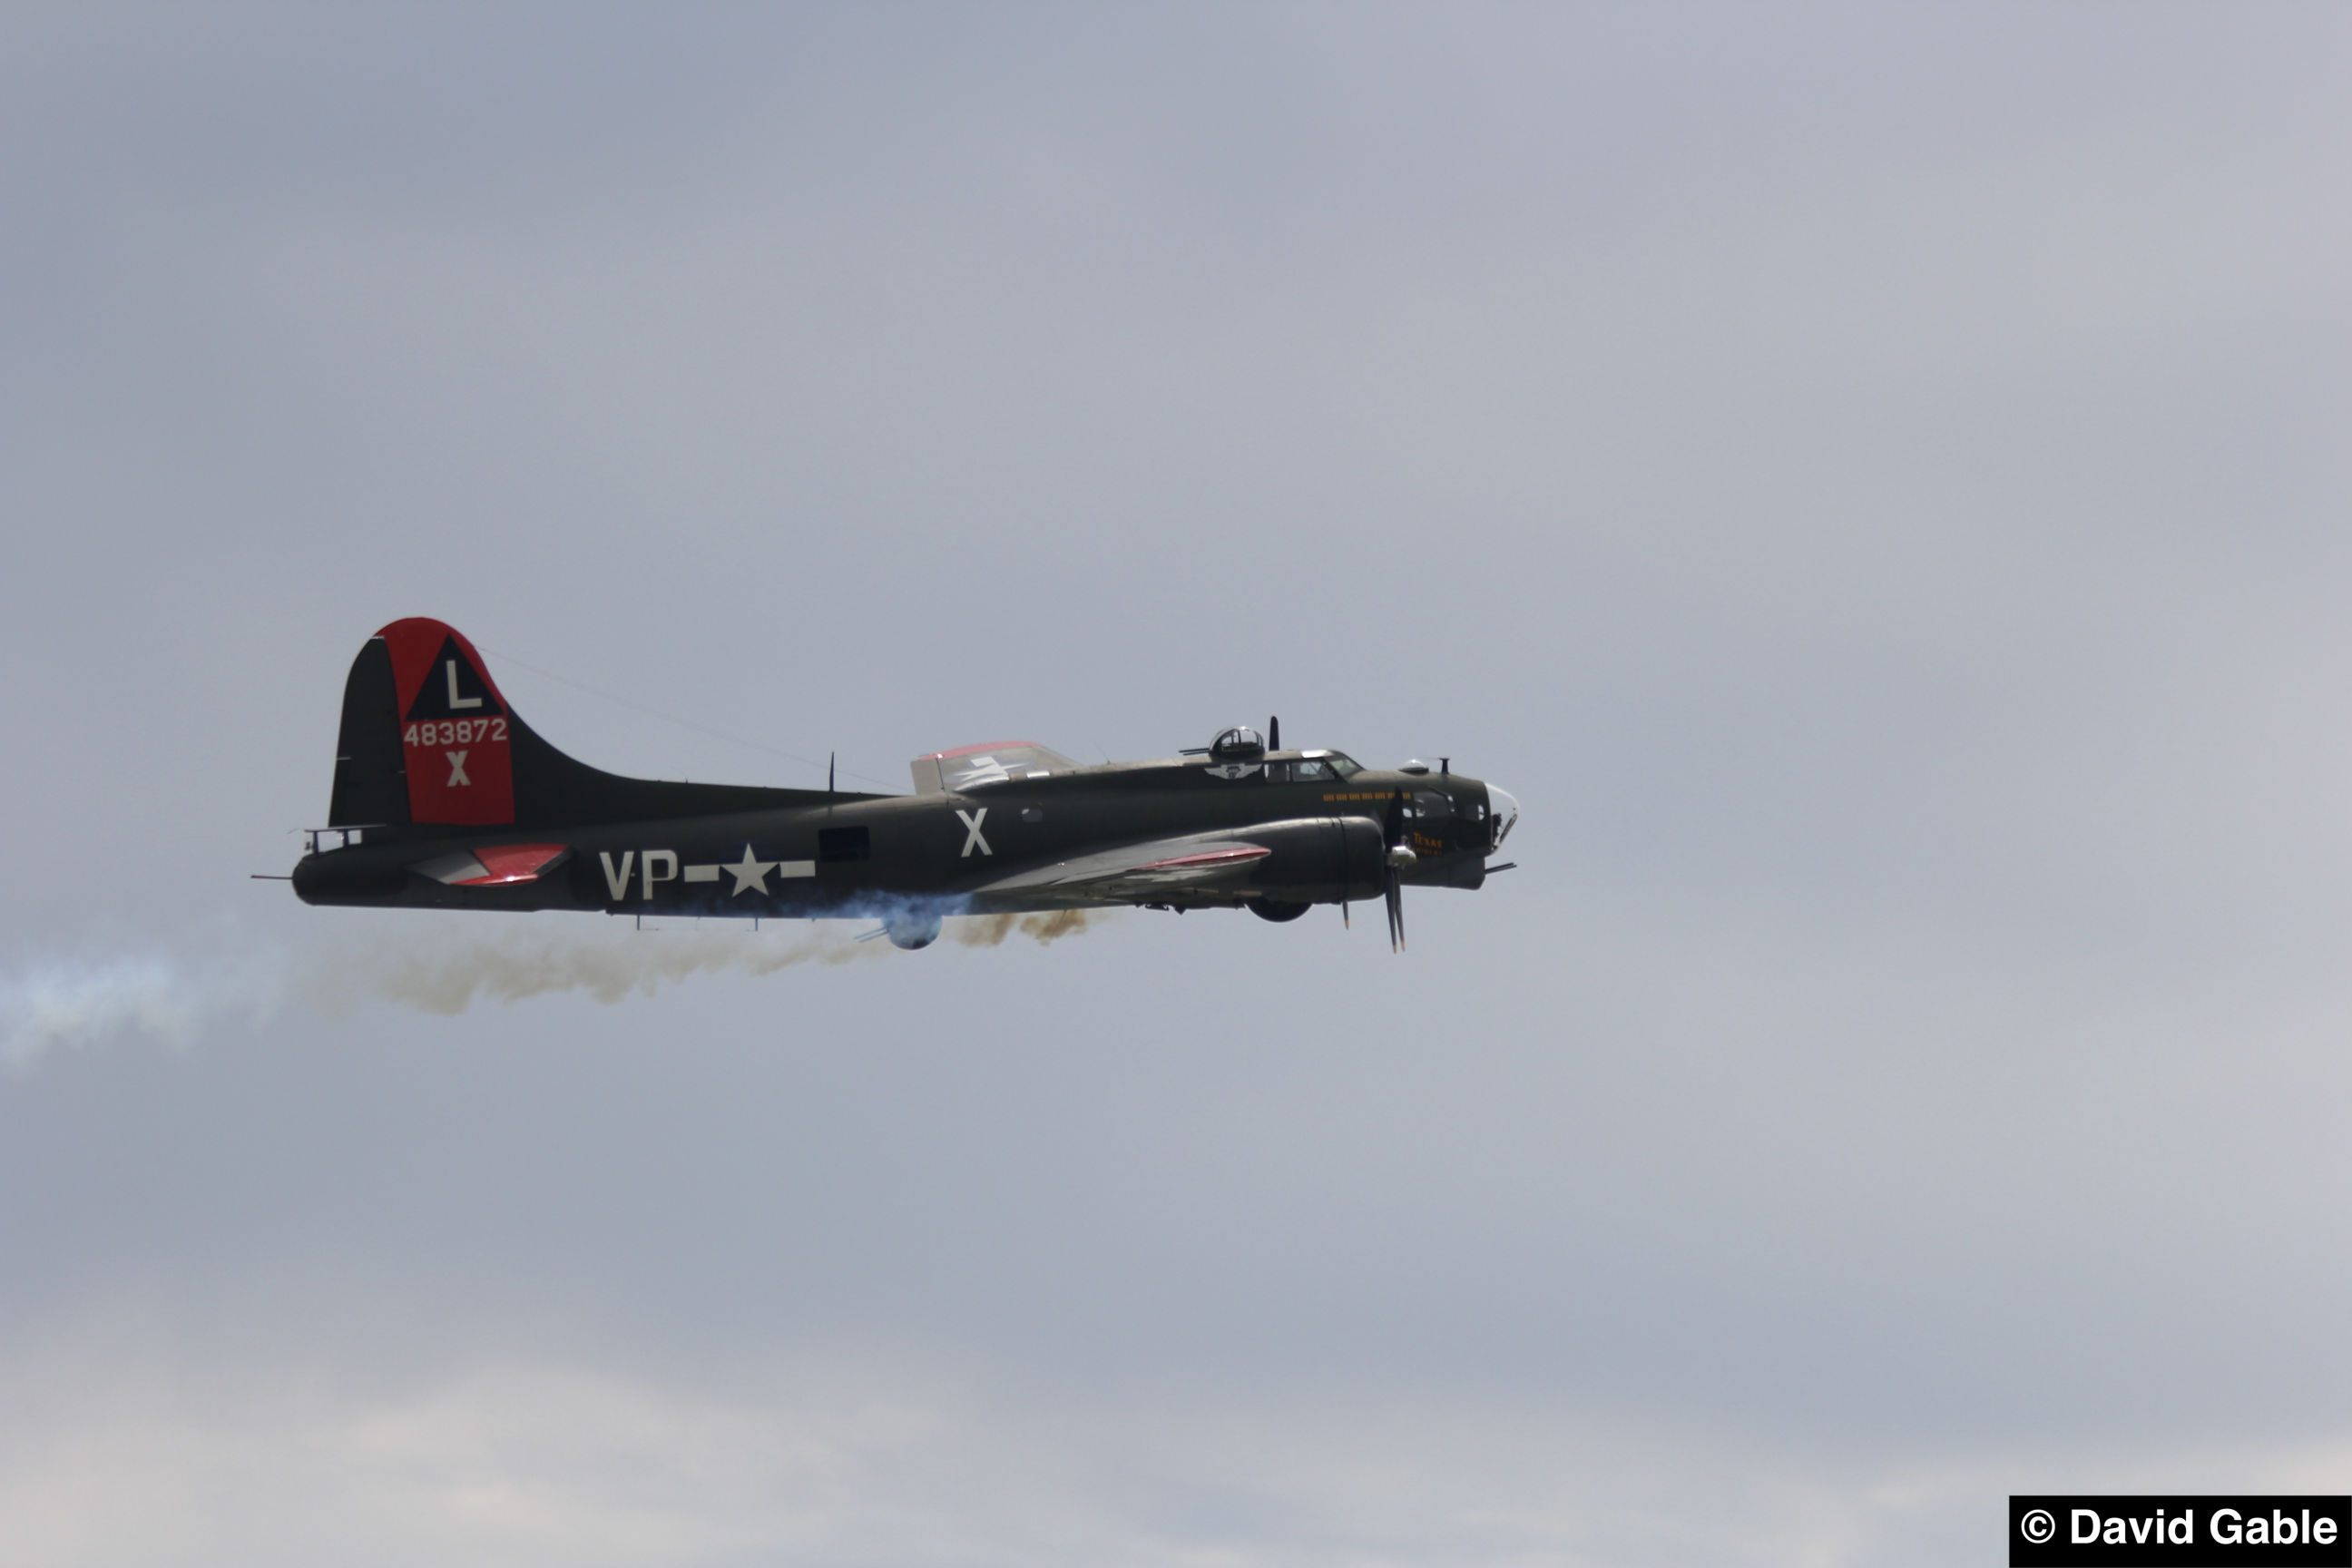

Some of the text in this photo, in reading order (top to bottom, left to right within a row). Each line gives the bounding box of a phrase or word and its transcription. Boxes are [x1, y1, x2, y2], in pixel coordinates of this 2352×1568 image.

[446, 660, 483, 709] L
[403, 719, 508, 747] 483872
[445, 750, 472, 787] X
[956, 808, 994, 857] X
[599, 849, 679, 901] VP
